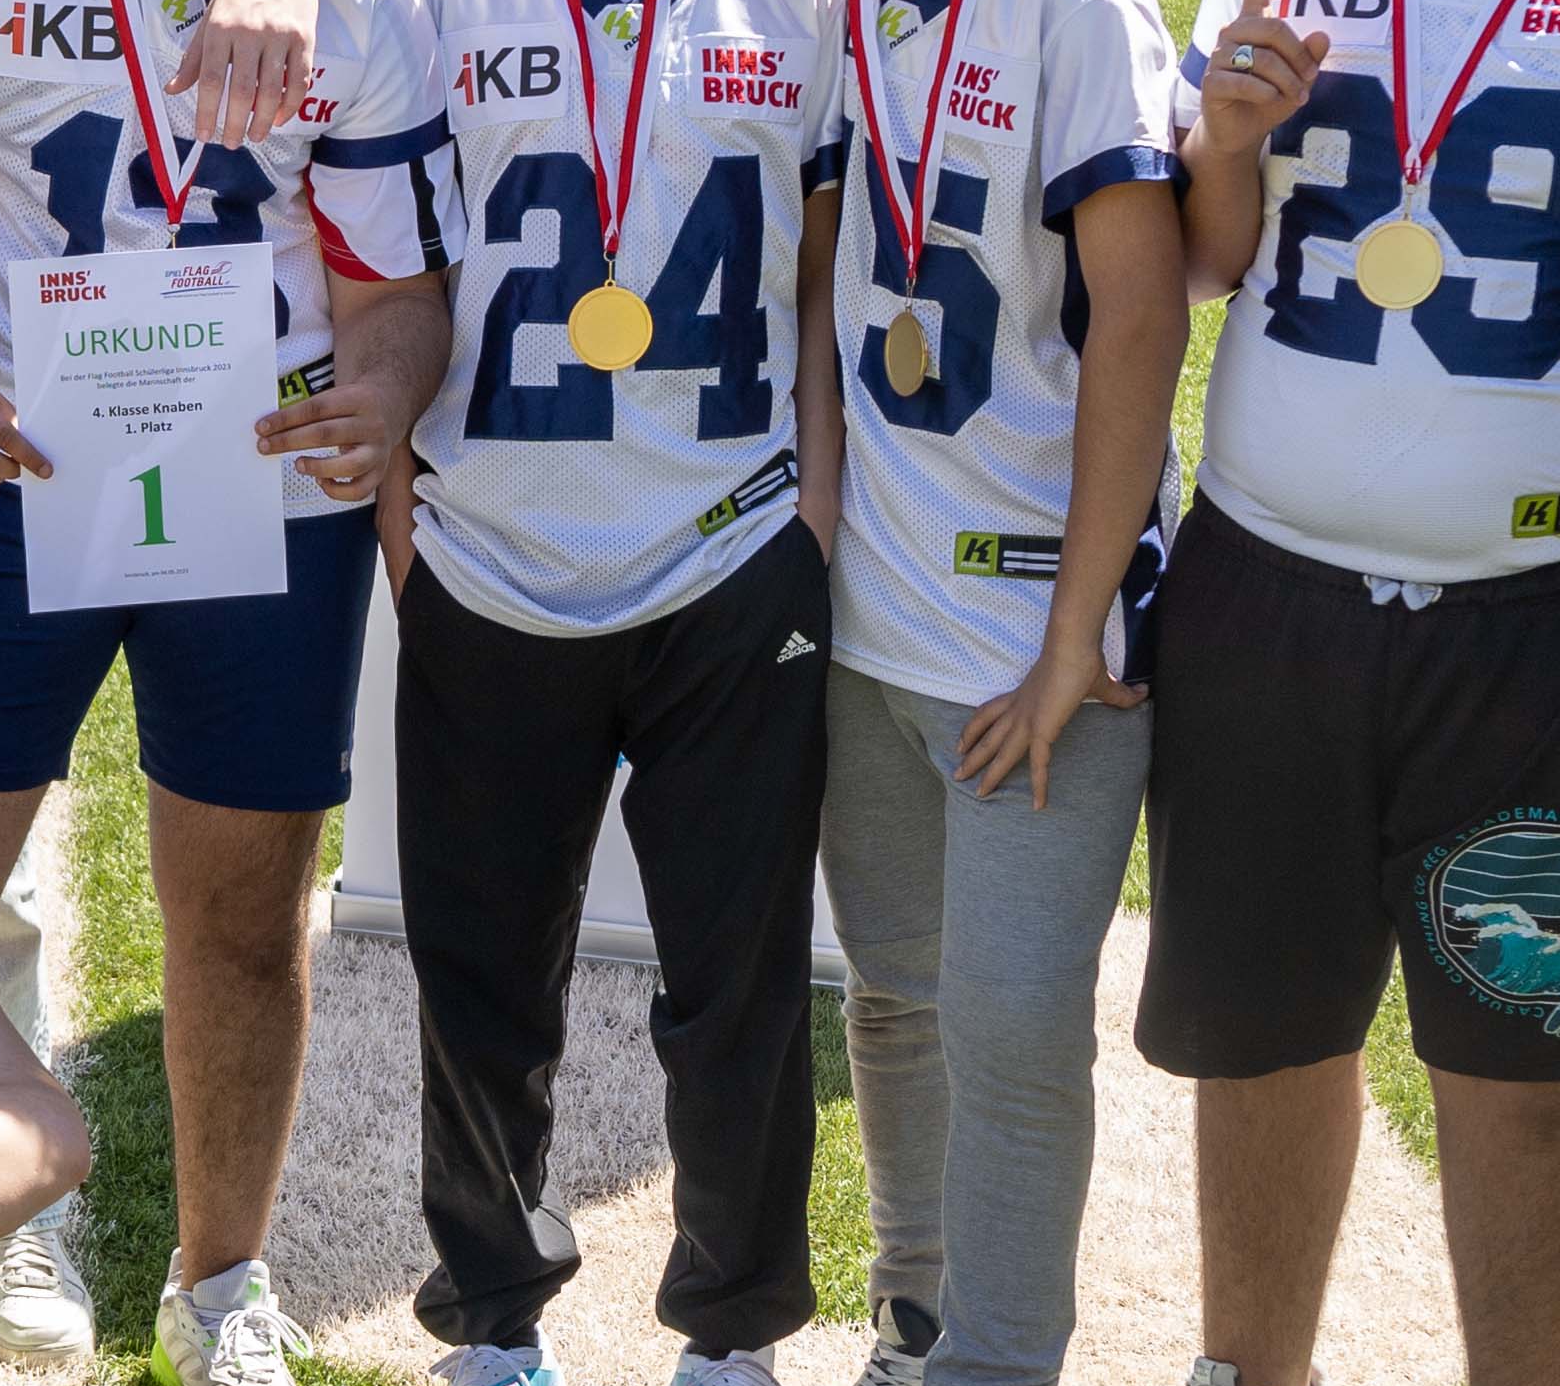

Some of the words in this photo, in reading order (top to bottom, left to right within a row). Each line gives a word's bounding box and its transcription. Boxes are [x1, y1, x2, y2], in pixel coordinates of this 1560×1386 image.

[702, 47, 784, 77] INNS'
[703, 75, 803, 110] BRUCK
[39, 270, 91, 288] INNS'
[170, 275, 224, 289] FOOTBALL
[183, 265, 210, 277] FLAG
[40, 285, 107, 304] BRUCK
[463, 151, 774, 442] 24
[857, 139, 1001, 437] 5
[64, 320, 225, 358] URKUNDE
[74, 372, 87, 382] der
[87, 371, 103, 383] Flag
[103, 369, 134, 380] Football
[134, 366, 175, 378] Schülerliga
[96, 379, 125, 391] belegte
[125, 378, 138, 389] die
[138, 376, 182, 388] Mannschaft
[182, 375, 196, 385] der
[92, 406, 105, 419] 4.
[108, 404, 150, 418] Klasse
[153, 401, 204, 416] Knaben
[125, 423, 138, 435] 1.
[141, 421, 173, 434] Platz
[128, 463, 178, 548] 1
[776, 640, 817, 664] adidas
[1418, 899, 1463, 985] CLOTHING
[1467, 985, 1545, 1019] CASUAL
